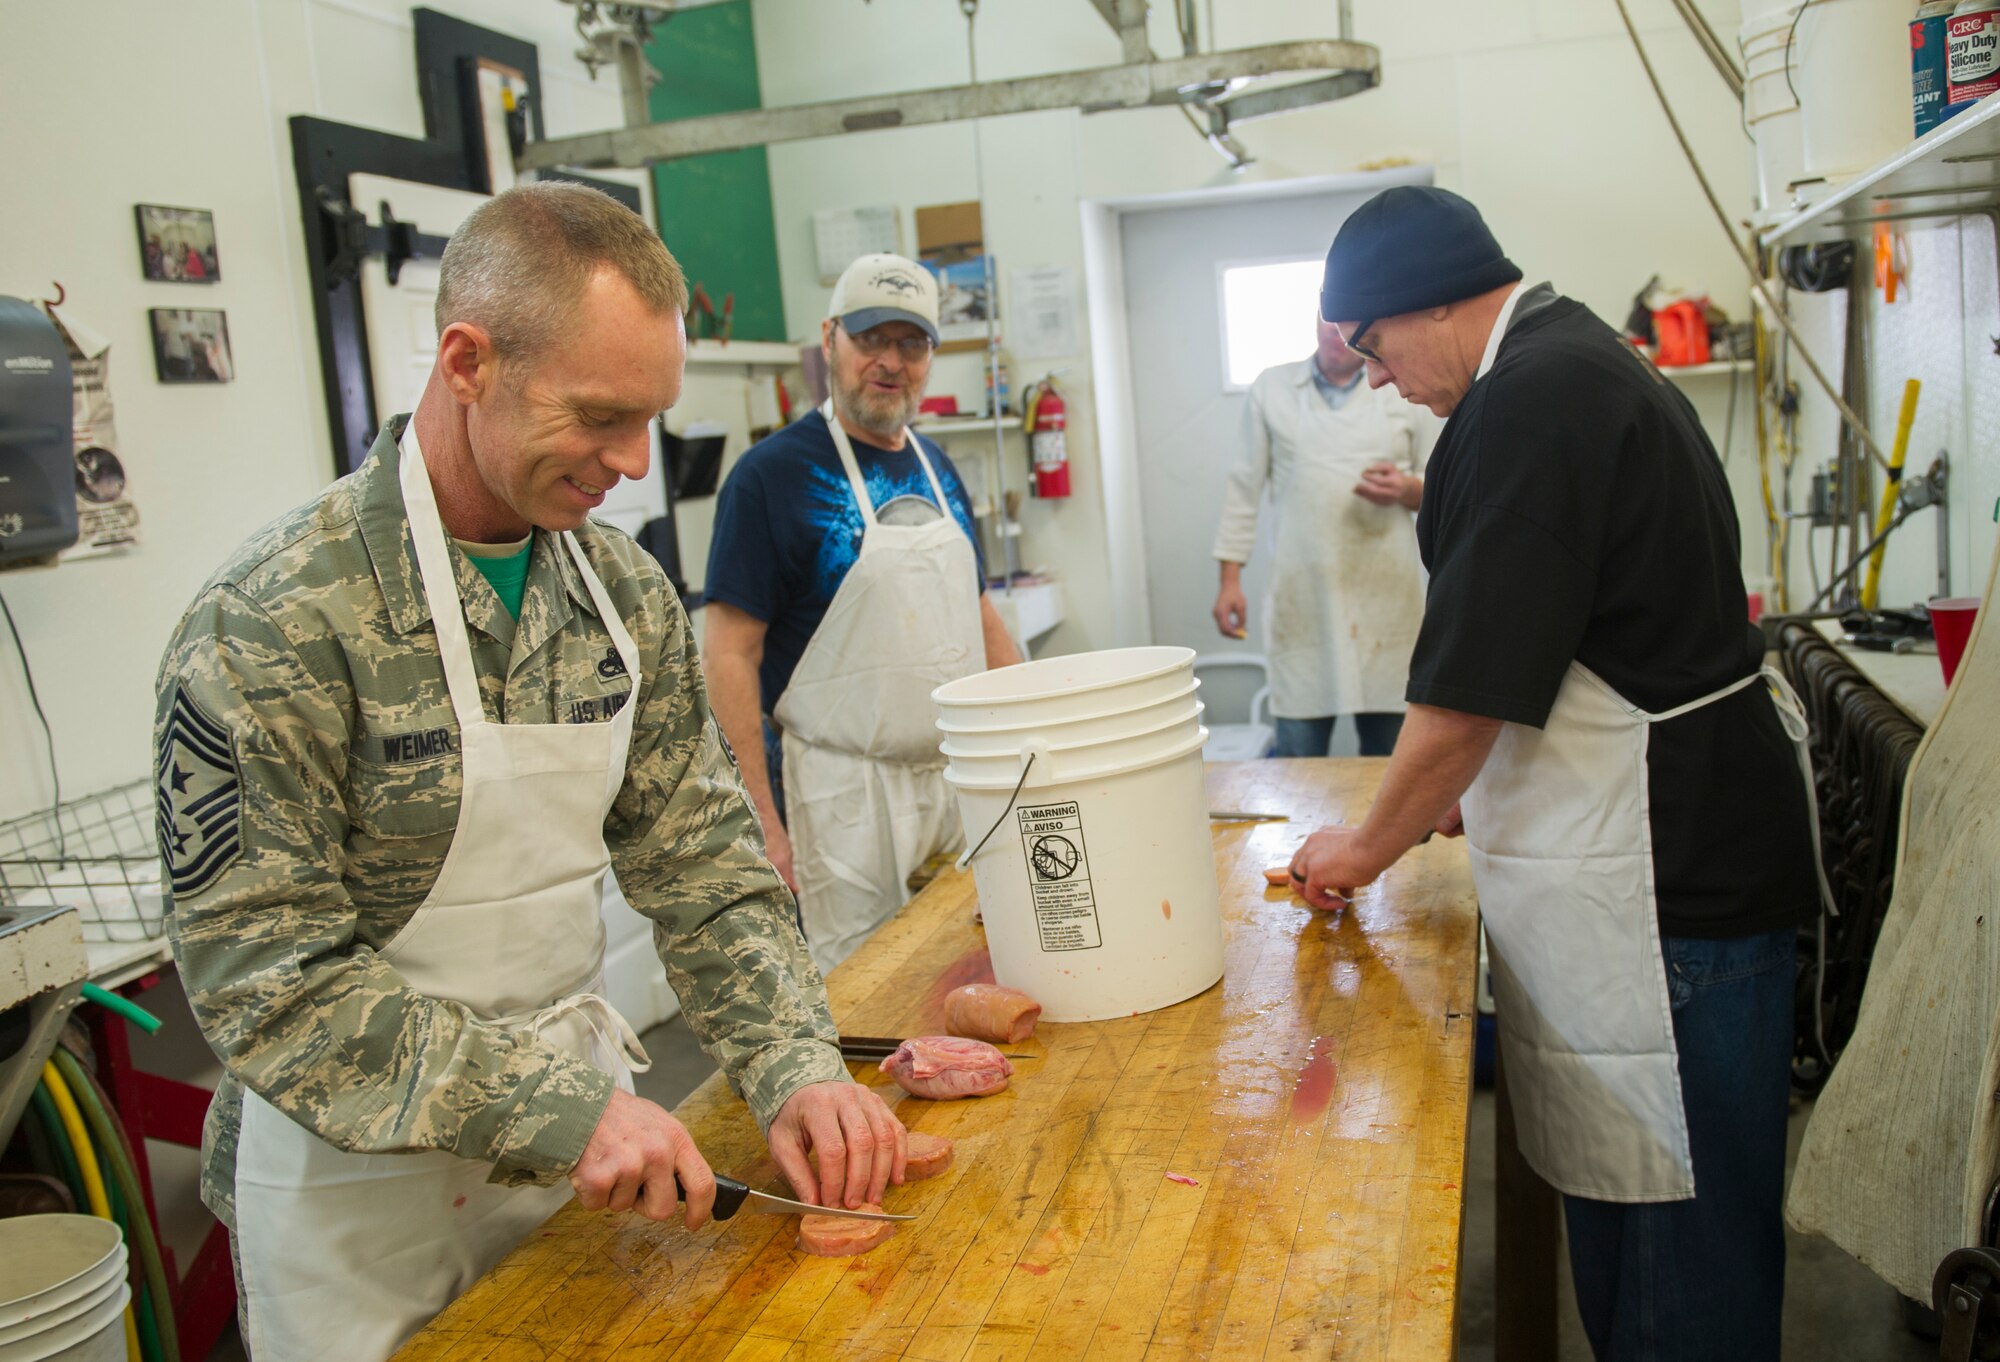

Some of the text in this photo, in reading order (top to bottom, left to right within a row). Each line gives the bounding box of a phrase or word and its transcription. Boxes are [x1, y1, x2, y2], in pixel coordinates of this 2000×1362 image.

[1952, 18, 1982, 34] CRC
[1972, 34, 1997, 48] Duty
[1950, 51, 1992, 69] Silicone
[384, 728, 452, 763] WEIMER
[1030, 806, 1076, 818] WARNING
[1034, 822, 1063, 831] AVISO
